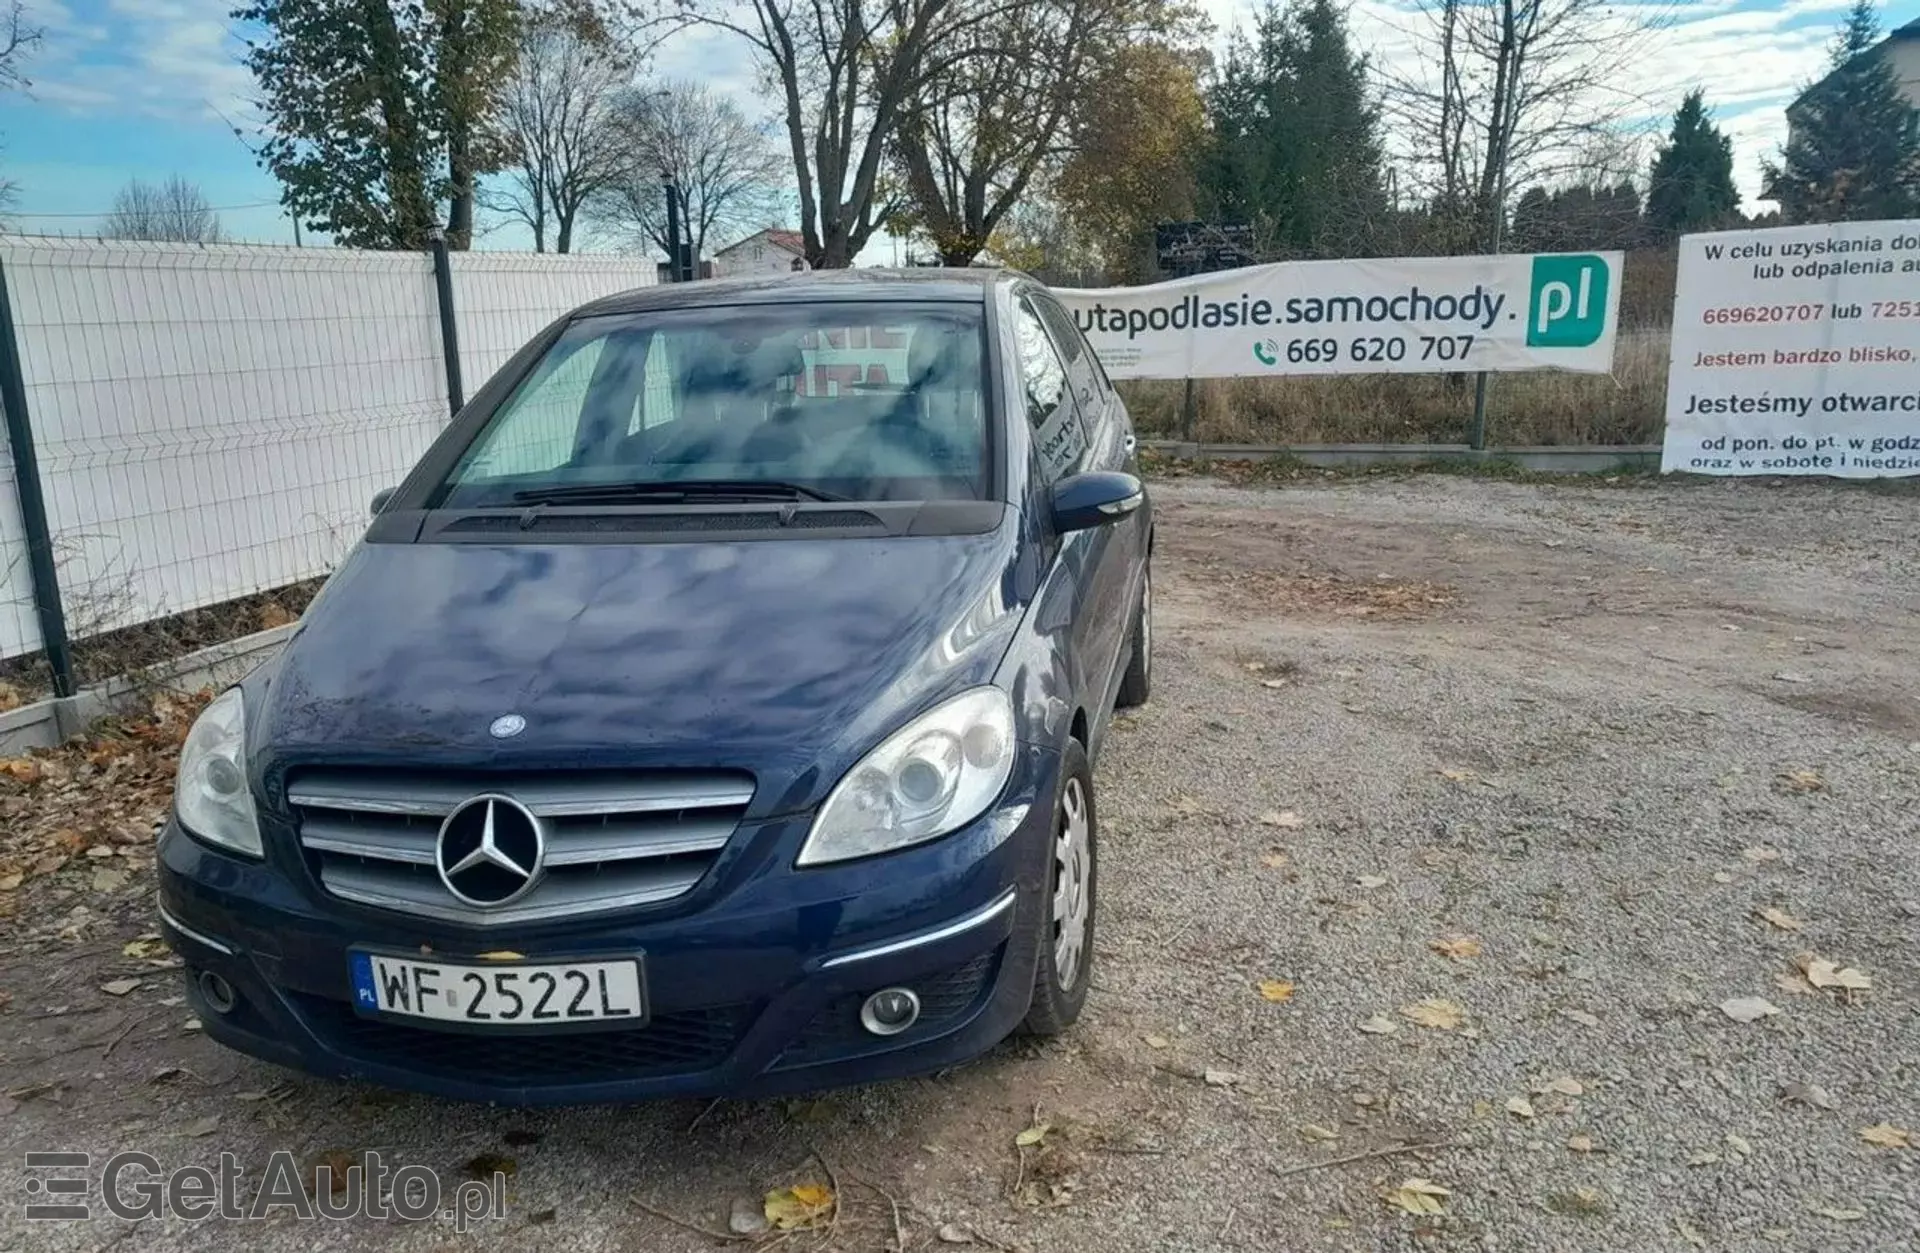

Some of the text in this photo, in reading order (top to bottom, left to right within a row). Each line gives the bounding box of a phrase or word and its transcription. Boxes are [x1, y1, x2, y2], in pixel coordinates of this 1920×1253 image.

[1704, 245, 1724, 260] W
[1730, 242, 1773, 259] celu
[1780, 236, 1883, 259] uzyskania
[1753, 264, 1784, 279] lub
[1791, 258, 1894, 280] odpalenia
[1703, 304, 1824, 324] 669620707
[1831, 303, 1862, 319] lub
[1287, 335, 1474, 363] 669 620 707
[1694, 352, 1766, 367] Jestem
[1773, 349, 1842, 365] bardzo
[1684, 391, 1812, 417] Jesteśmy
[1701, 436, 1726, 450] od
[1732, 439, 1775, 452] pon.
[1782, 435, 1807, 449] do
[1849, 439, 1865, 449] w
[1690, 458, 1732, 468] oraz
[1739, 459, 1756, 468] w
[1840, 452, 1846, 466] i
[359, 988, 375, 1003] PL
[379, 963, 631, 1020] WF 2522L
